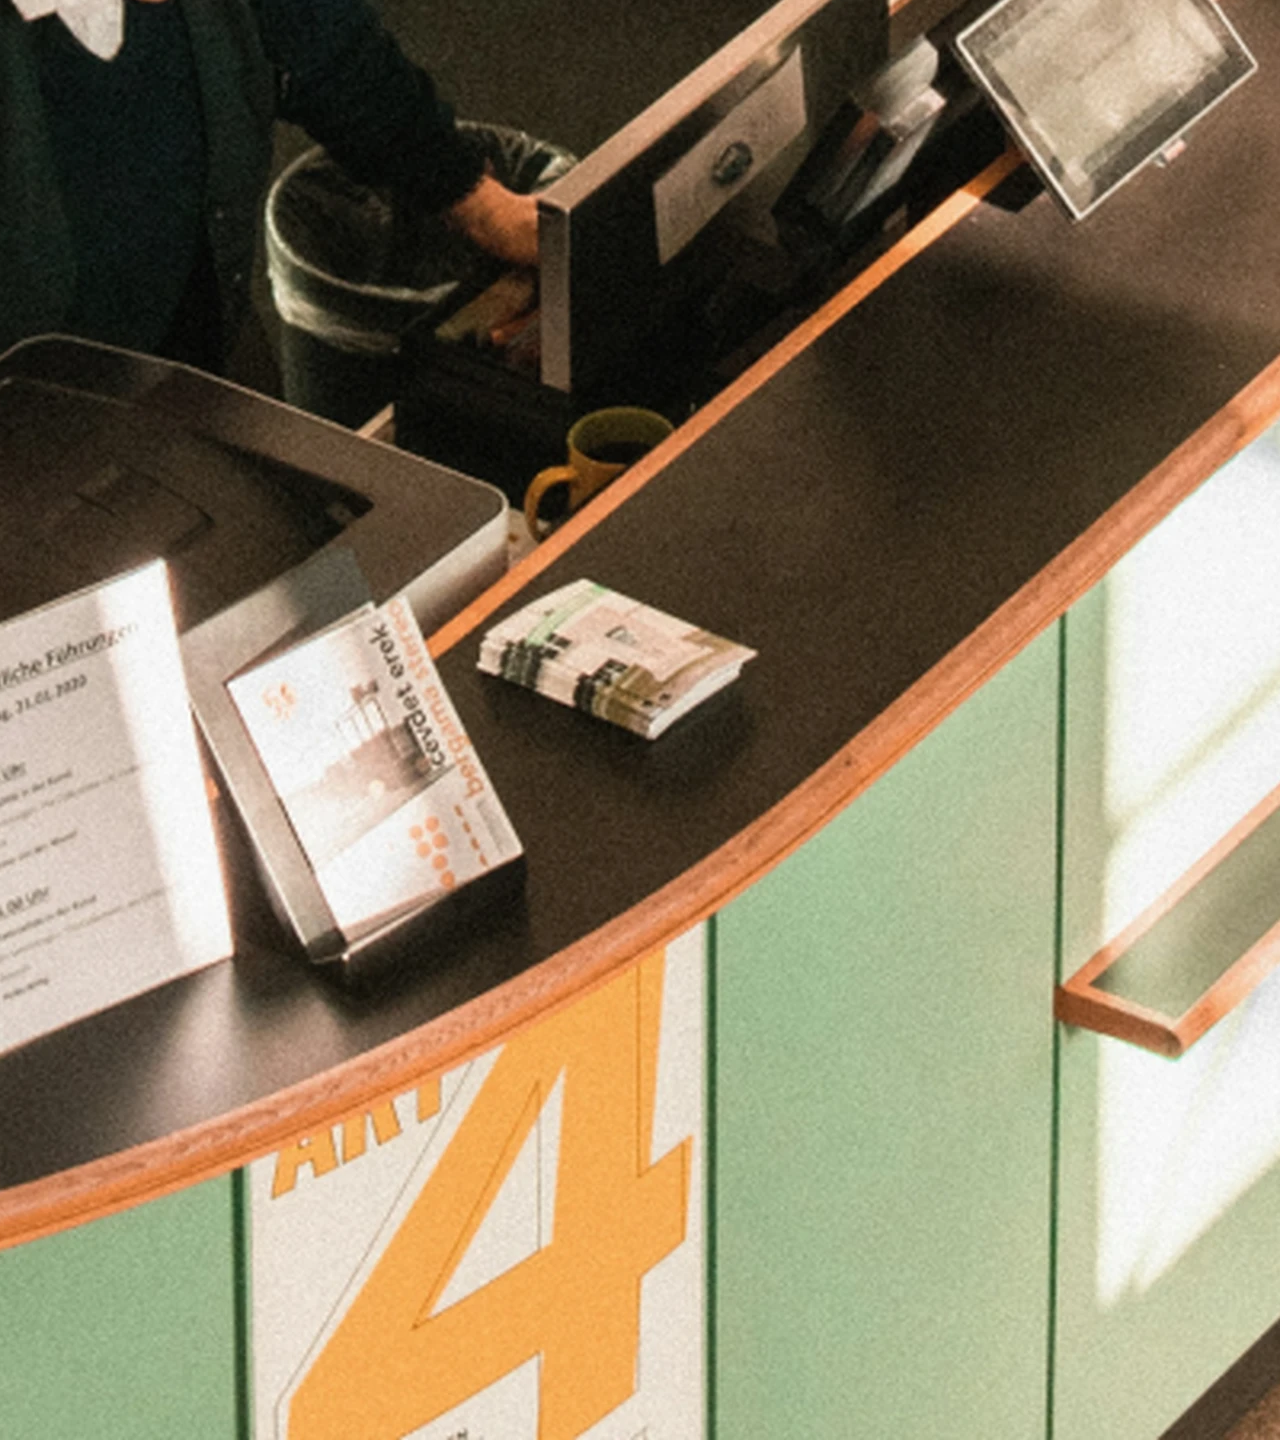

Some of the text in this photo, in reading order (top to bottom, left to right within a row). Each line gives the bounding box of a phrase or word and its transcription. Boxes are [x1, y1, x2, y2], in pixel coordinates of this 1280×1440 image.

[370, 622, 447, 768] cevdet erek
[424, 685, 485, 798] bergama
